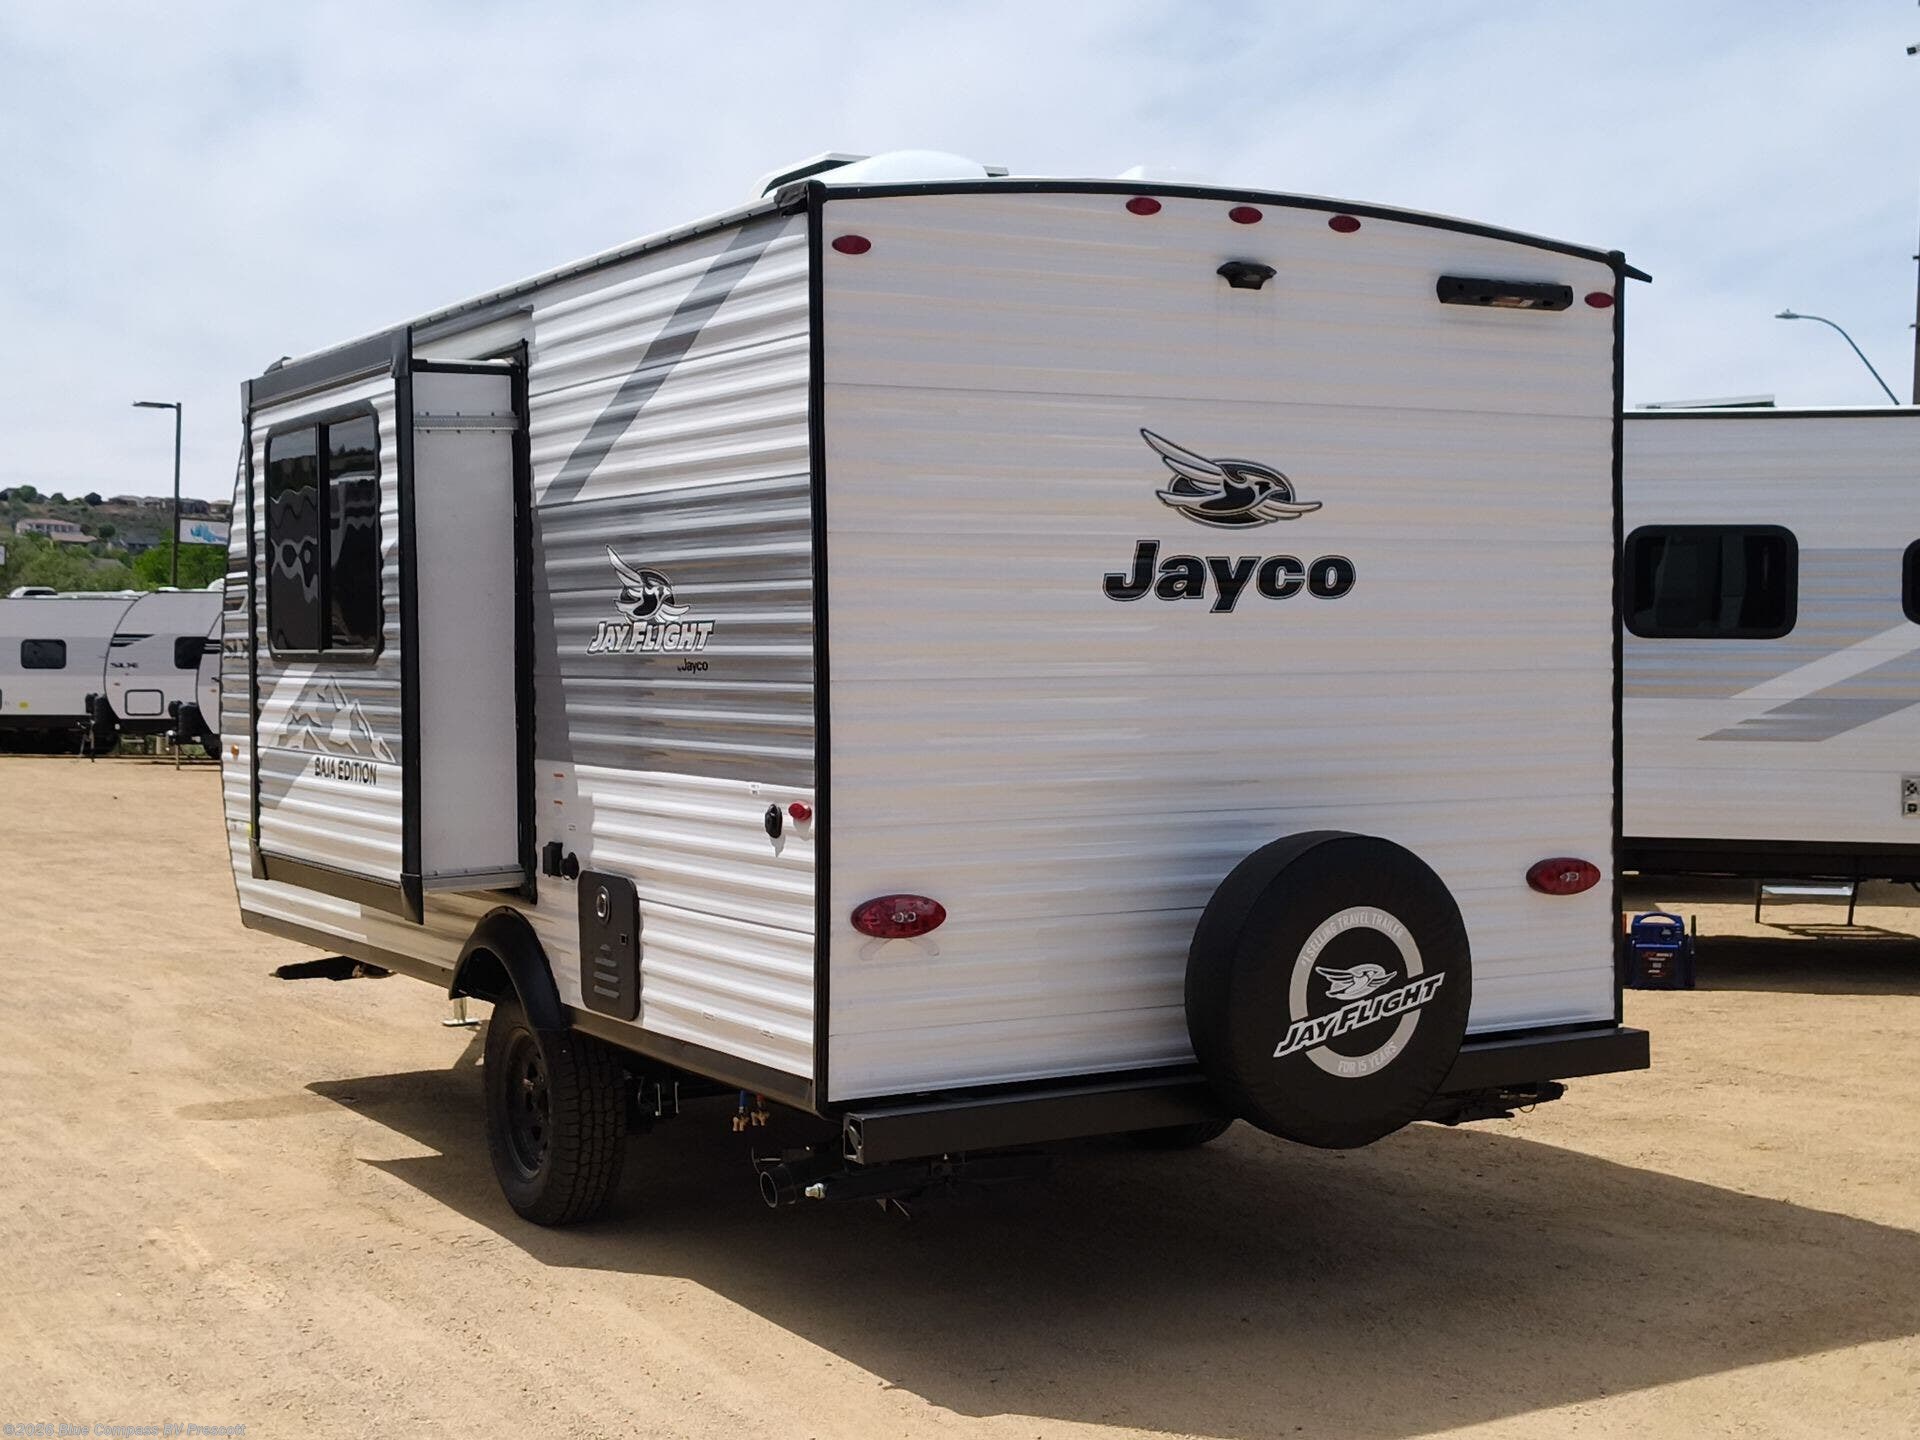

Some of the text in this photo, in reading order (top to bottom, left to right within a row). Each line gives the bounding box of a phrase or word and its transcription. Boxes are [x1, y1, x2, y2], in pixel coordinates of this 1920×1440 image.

[1102, 539, 1357, 614] Jayco
[586, 620, 715, 654] JAY FLIGHT
[677, 659, 709, 674] Jayco
[314, 757, 377, 785] BAJA EDITION
[1338, 911, 1369, 930] TRAVEL
[1273, 971, 1446, 1058] JAY FLIGHT
